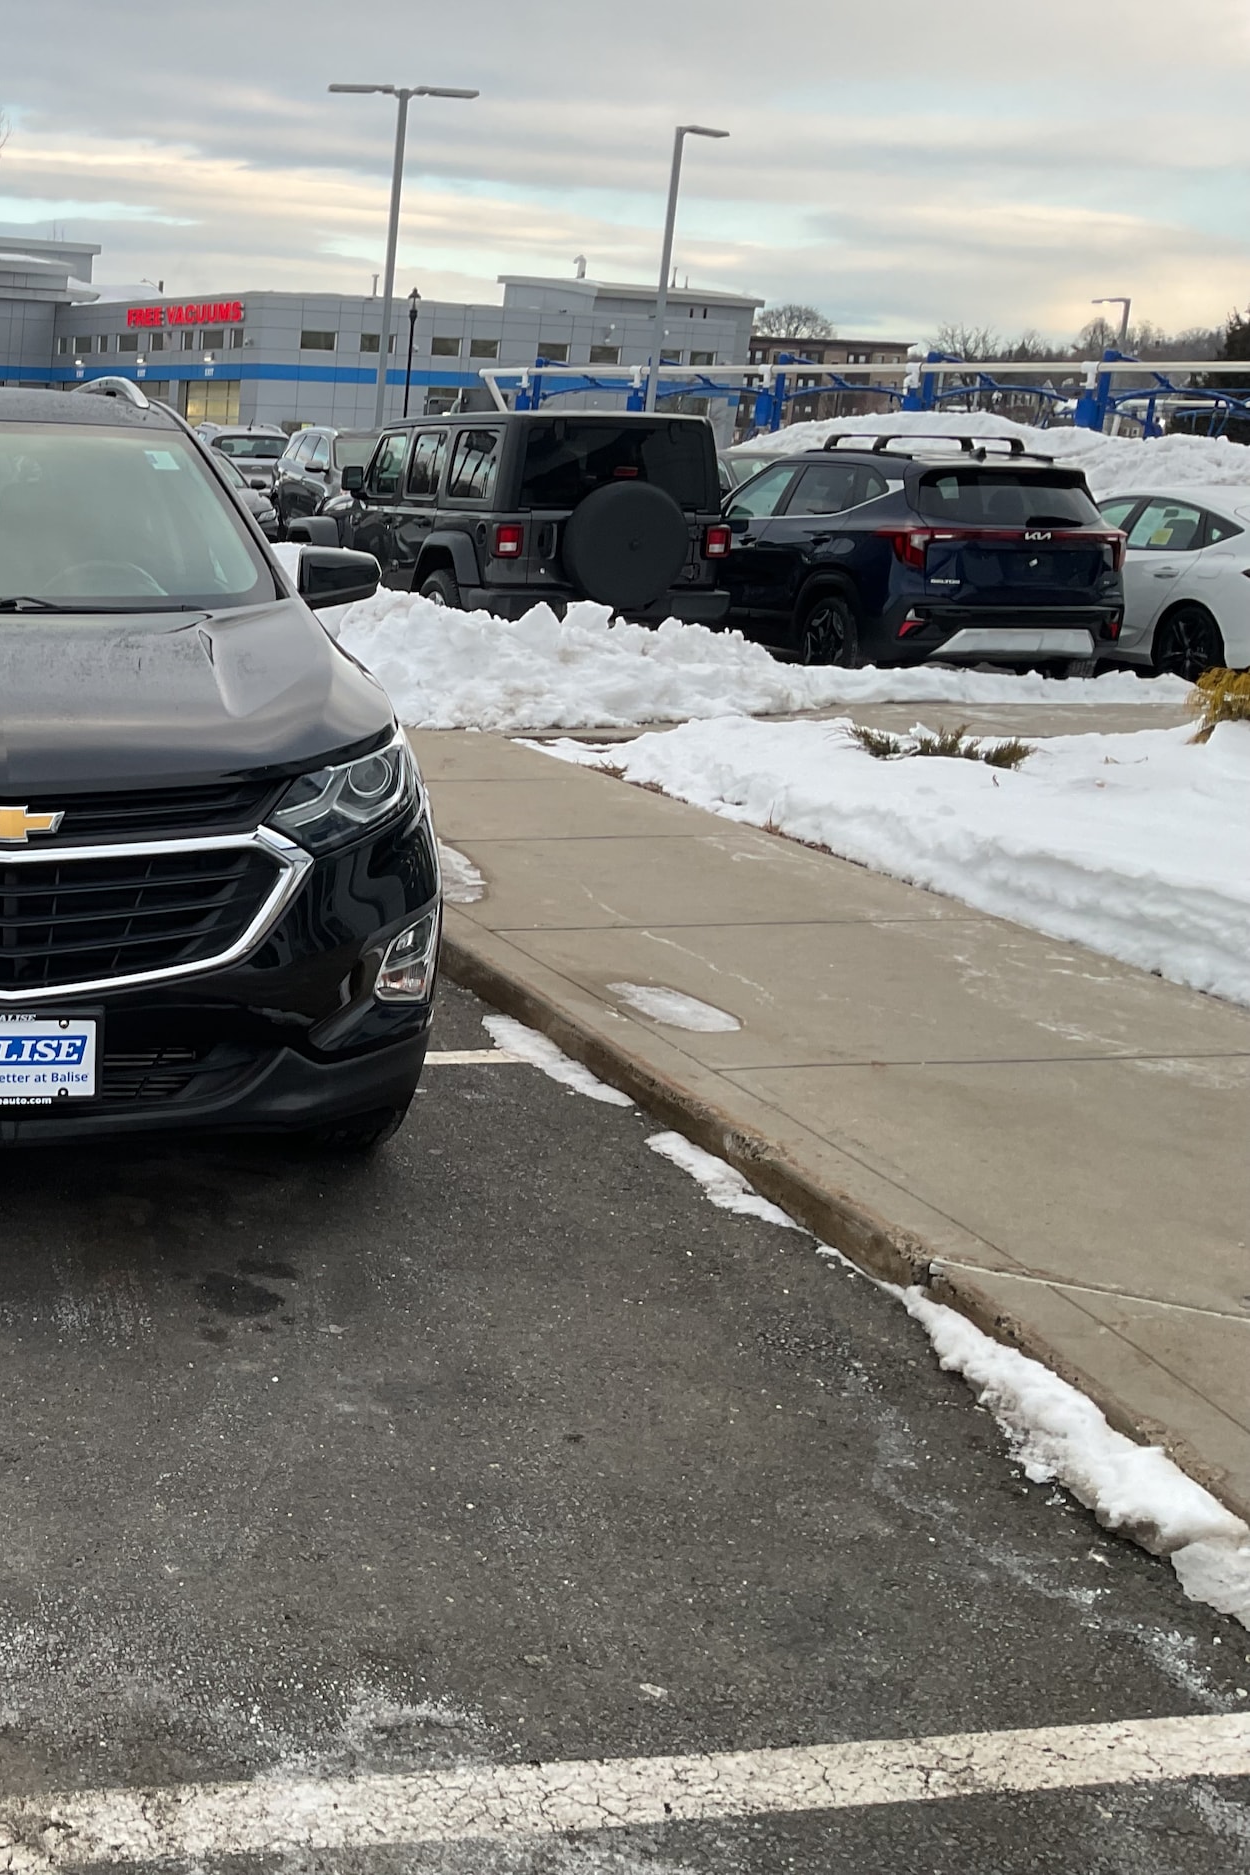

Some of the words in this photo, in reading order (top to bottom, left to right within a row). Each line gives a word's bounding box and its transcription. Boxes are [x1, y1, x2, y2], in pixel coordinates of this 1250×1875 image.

[127, 303, 163, 327] FREE
[166, 301, 242, 325] VACUUMS
[1025, 532, 1051, 540] KIA
[34, 1073, 47, 1083] at
[51, 1072, 88, 1082] Balise
